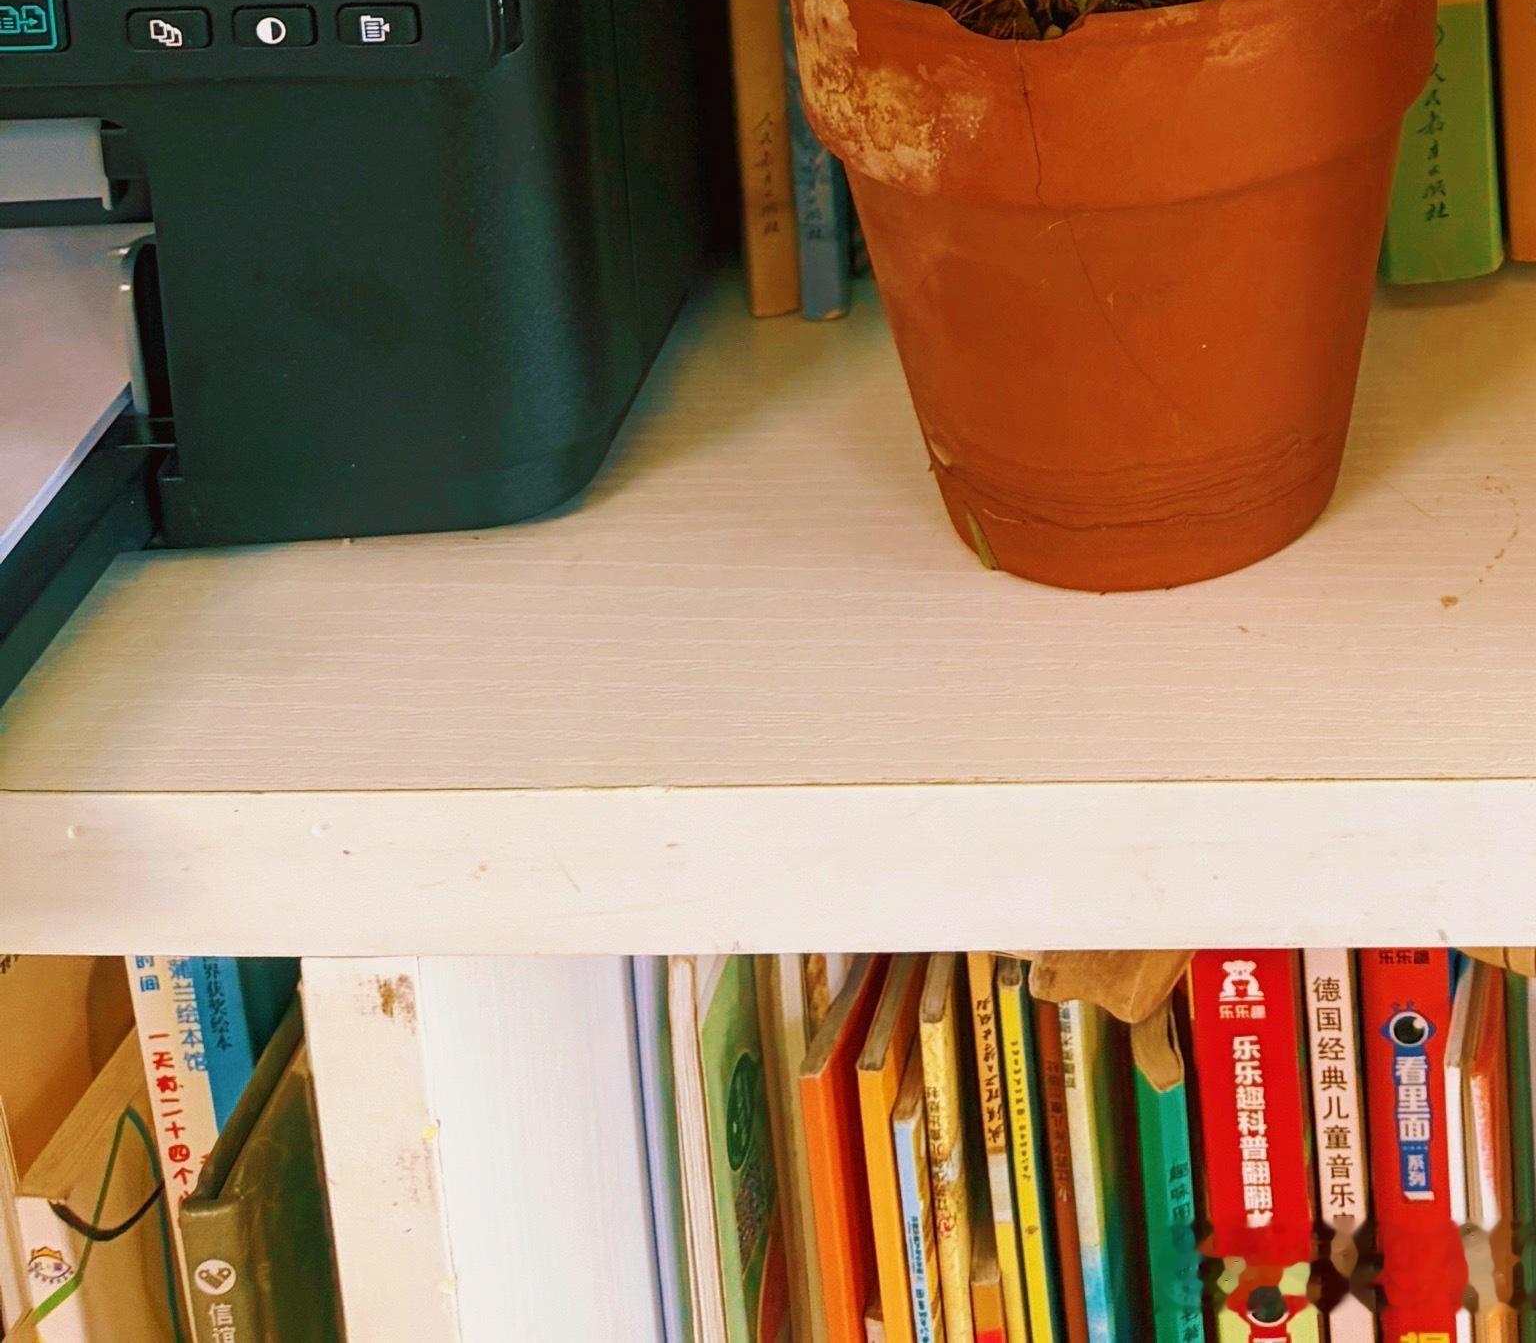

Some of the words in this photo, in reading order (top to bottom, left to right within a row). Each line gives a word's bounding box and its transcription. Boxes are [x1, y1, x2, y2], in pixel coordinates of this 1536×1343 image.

[1313, 975, 1356, 1219] 德国经典儿童音乐
[1397, 1057, 1431, 1140] 看里面
[1408, 1155, 1427, 1187] 系列
